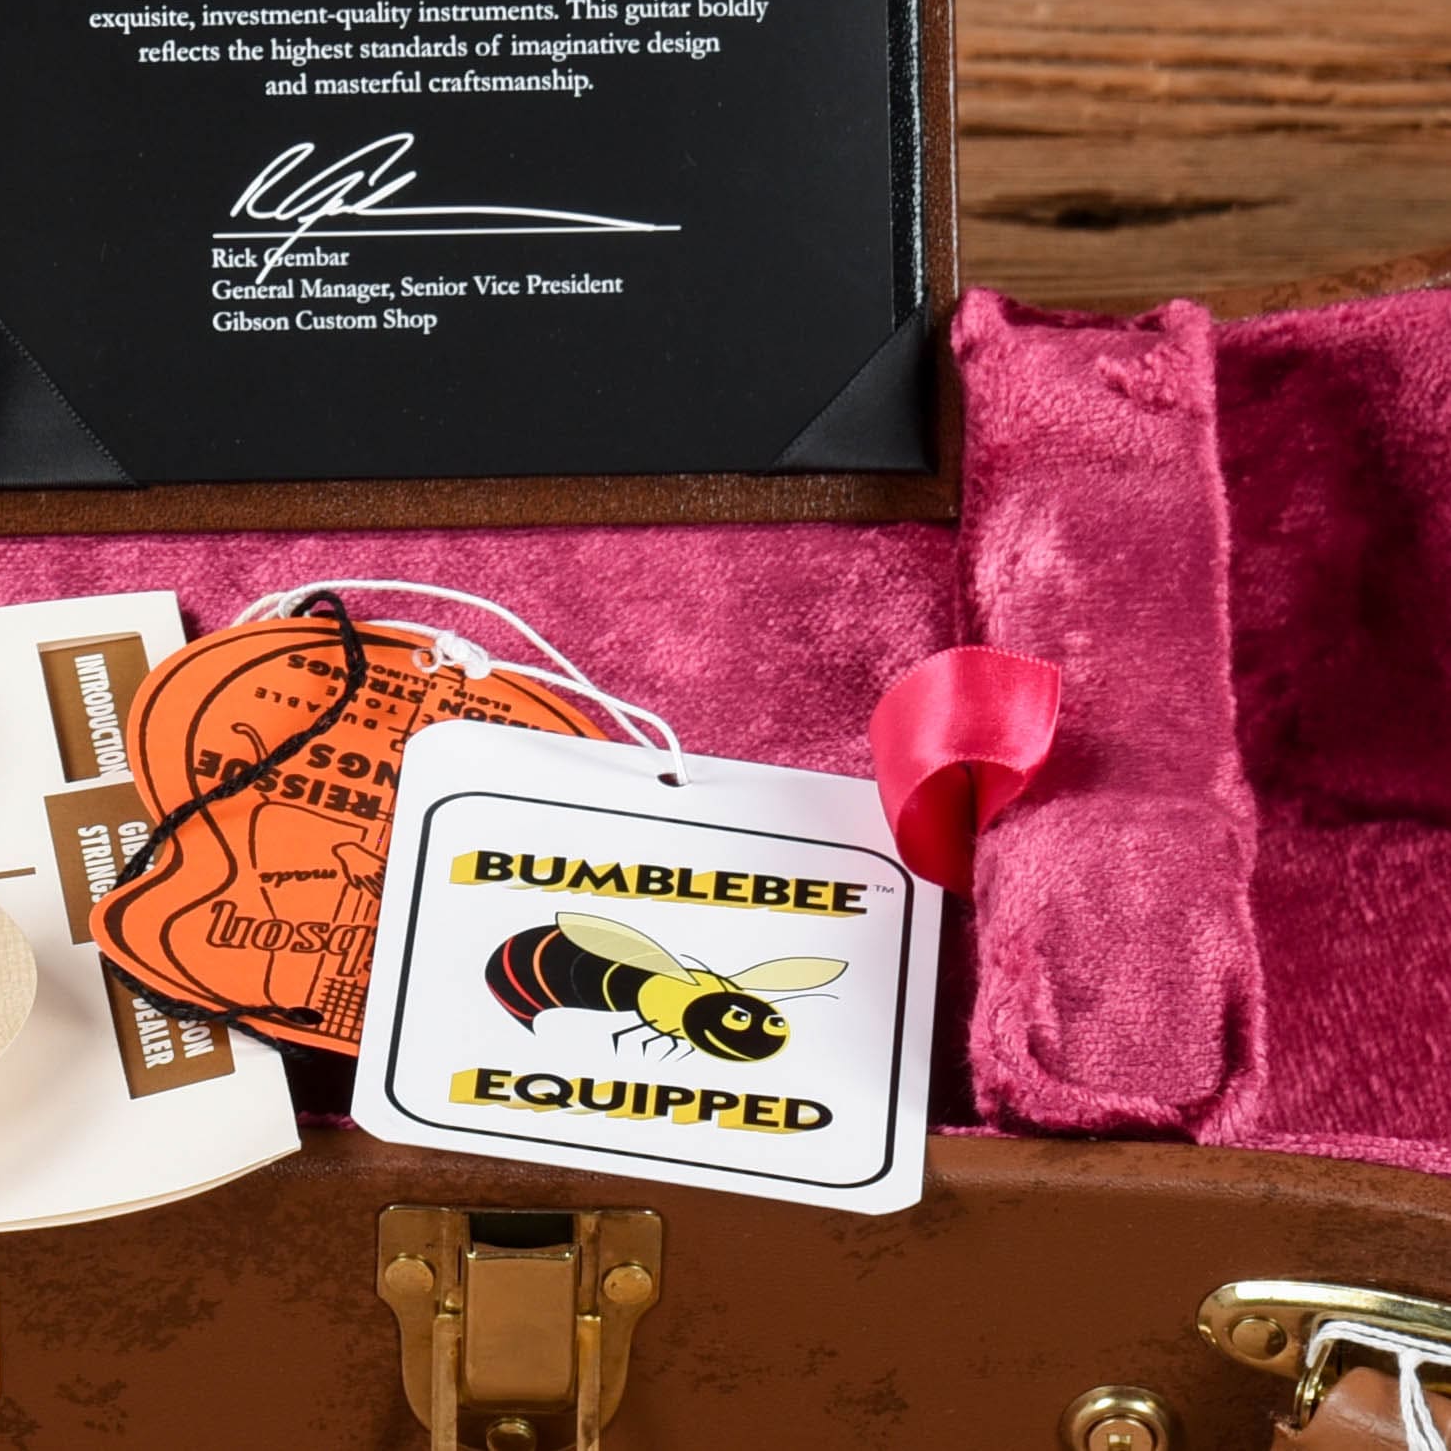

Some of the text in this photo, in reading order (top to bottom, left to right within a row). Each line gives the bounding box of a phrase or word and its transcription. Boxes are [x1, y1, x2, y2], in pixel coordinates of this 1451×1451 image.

[138, 29, 721, 67] reflects the highest standards of imaginative design
[265, 67, 594, 98] and masterful craftsmanship.
[211, 246, 351, 269] Rick Gembar
[211, 271, 624, 305] General Manager, Senior Vice President
[212, 306, 438, 336] Gibson Custom Shop
[73, 652, 130, 776] INTRODUCTION
[252, 686, 379, 730] DUABLE
[472, 849, 868, 916] BUMBLEBEE
[472, 1067, 834, 1133] EQUIPPED
